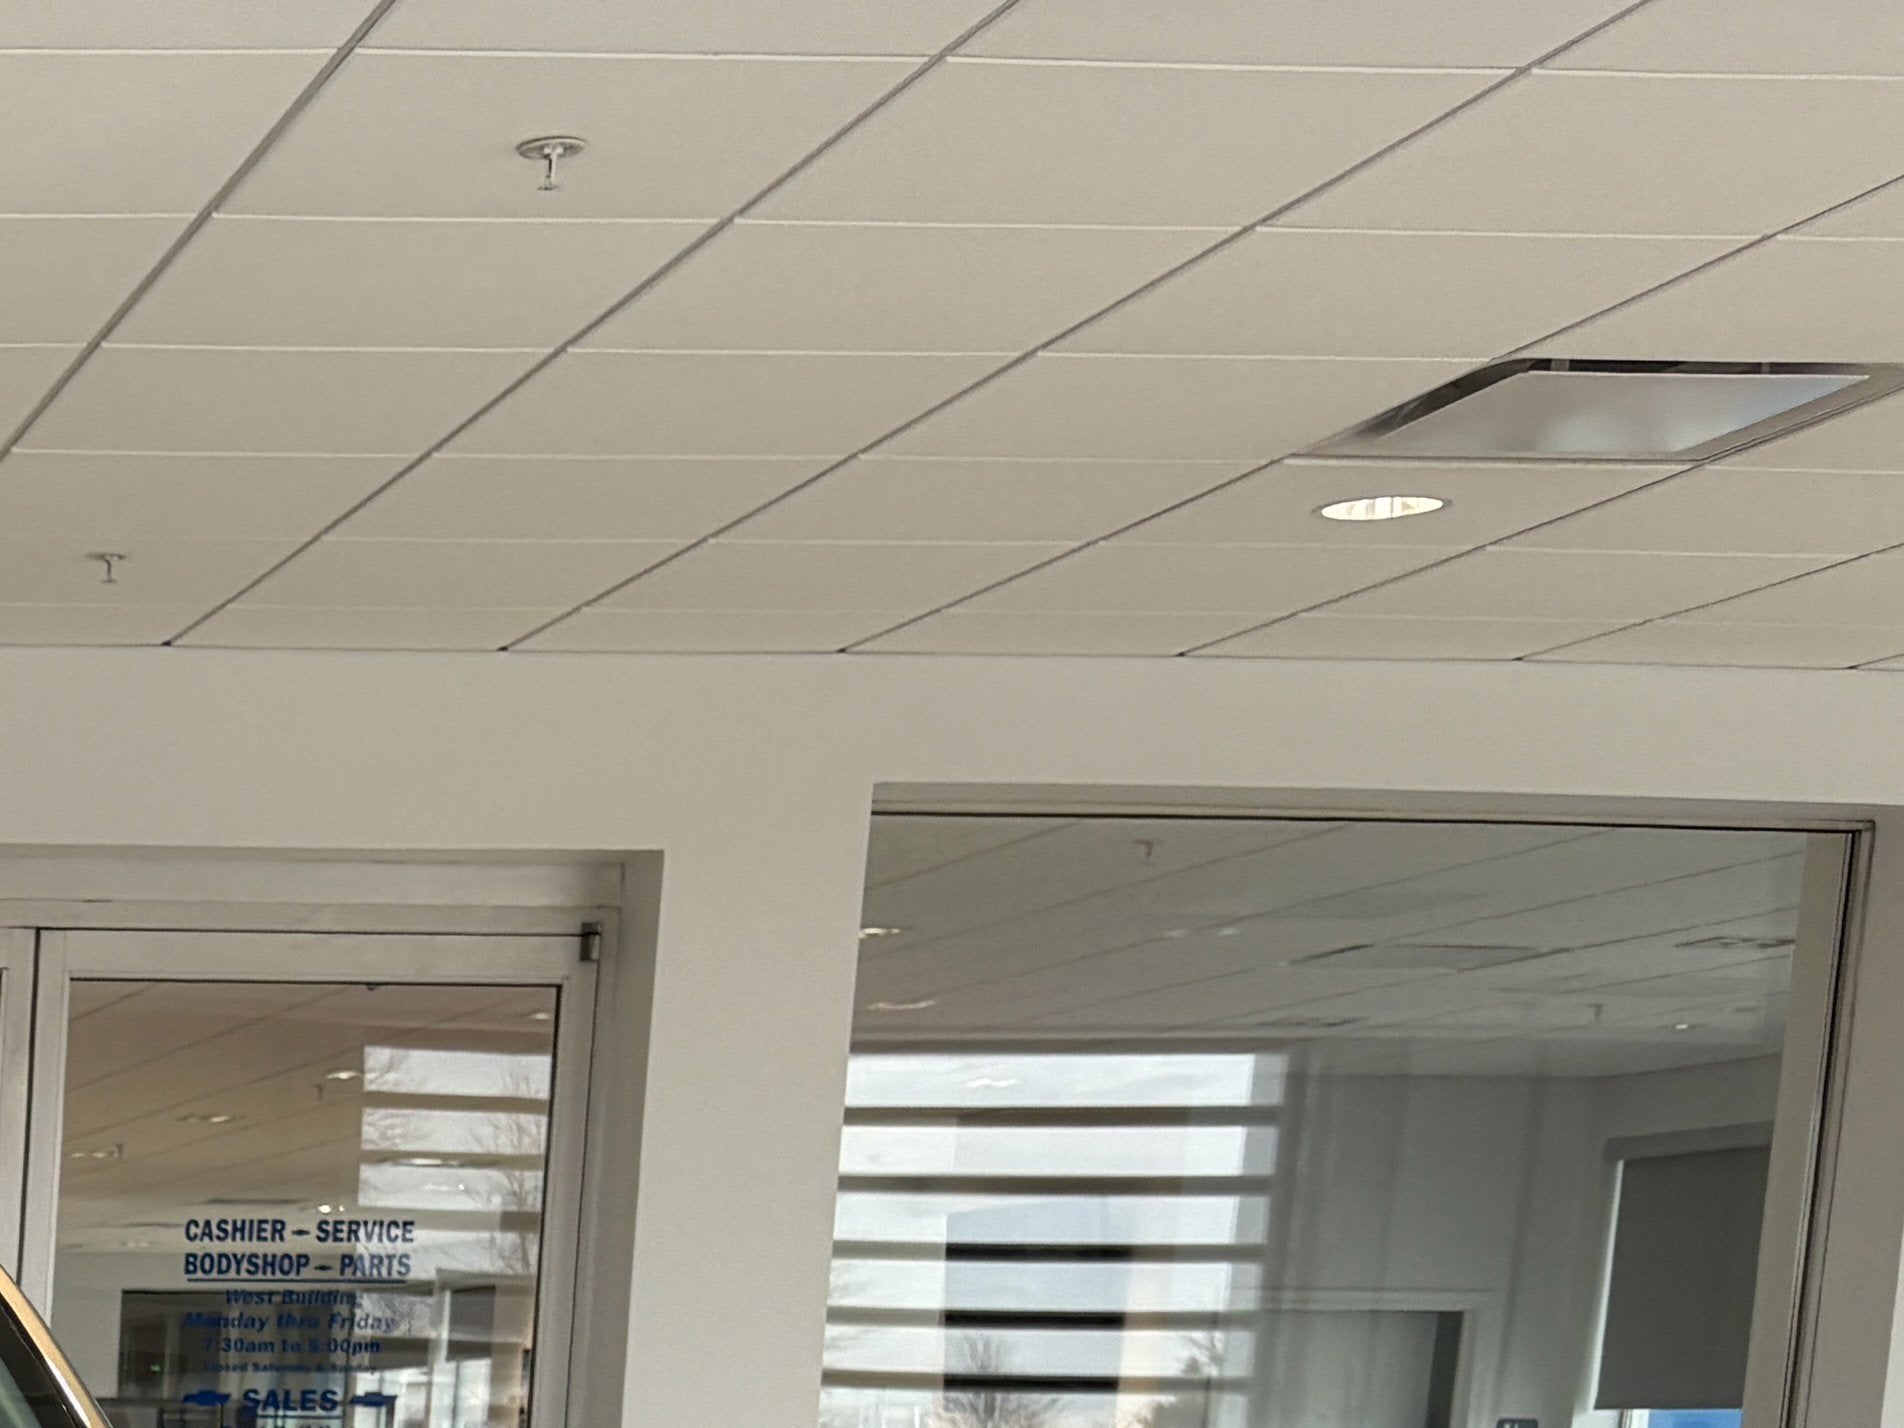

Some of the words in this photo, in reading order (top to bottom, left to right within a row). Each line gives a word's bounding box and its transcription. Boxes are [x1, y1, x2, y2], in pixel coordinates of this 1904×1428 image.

[184, 1218, 286, 1243] CASHIER
[315, 1219, 415, 1243] SERVICE
[183, 1252, 310, 1276] BODYSHOP
[339, 1253, 411, 1277] PARTS
[328, 1313, 397, 1334] Friday
[203, 1338, 275, 1353] 730am
[308, 1338, 380, 1356] 500pm
[242, 1389, 339, 1413] SALES
